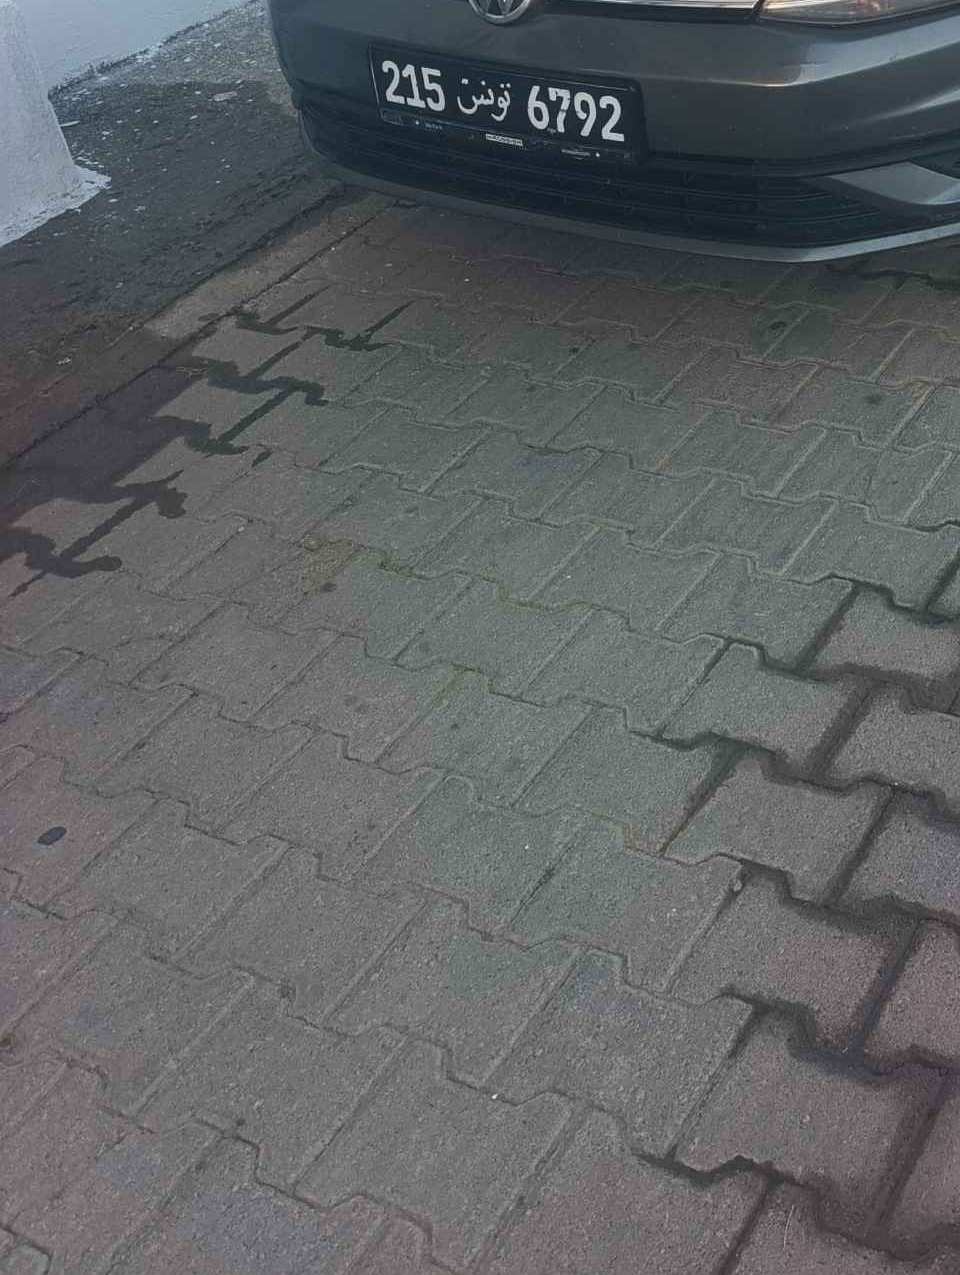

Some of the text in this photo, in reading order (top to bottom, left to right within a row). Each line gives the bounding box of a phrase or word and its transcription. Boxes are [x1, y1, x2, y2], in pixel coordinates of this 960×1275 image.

[381, 60, 625, 142] 215 تونس 6792
